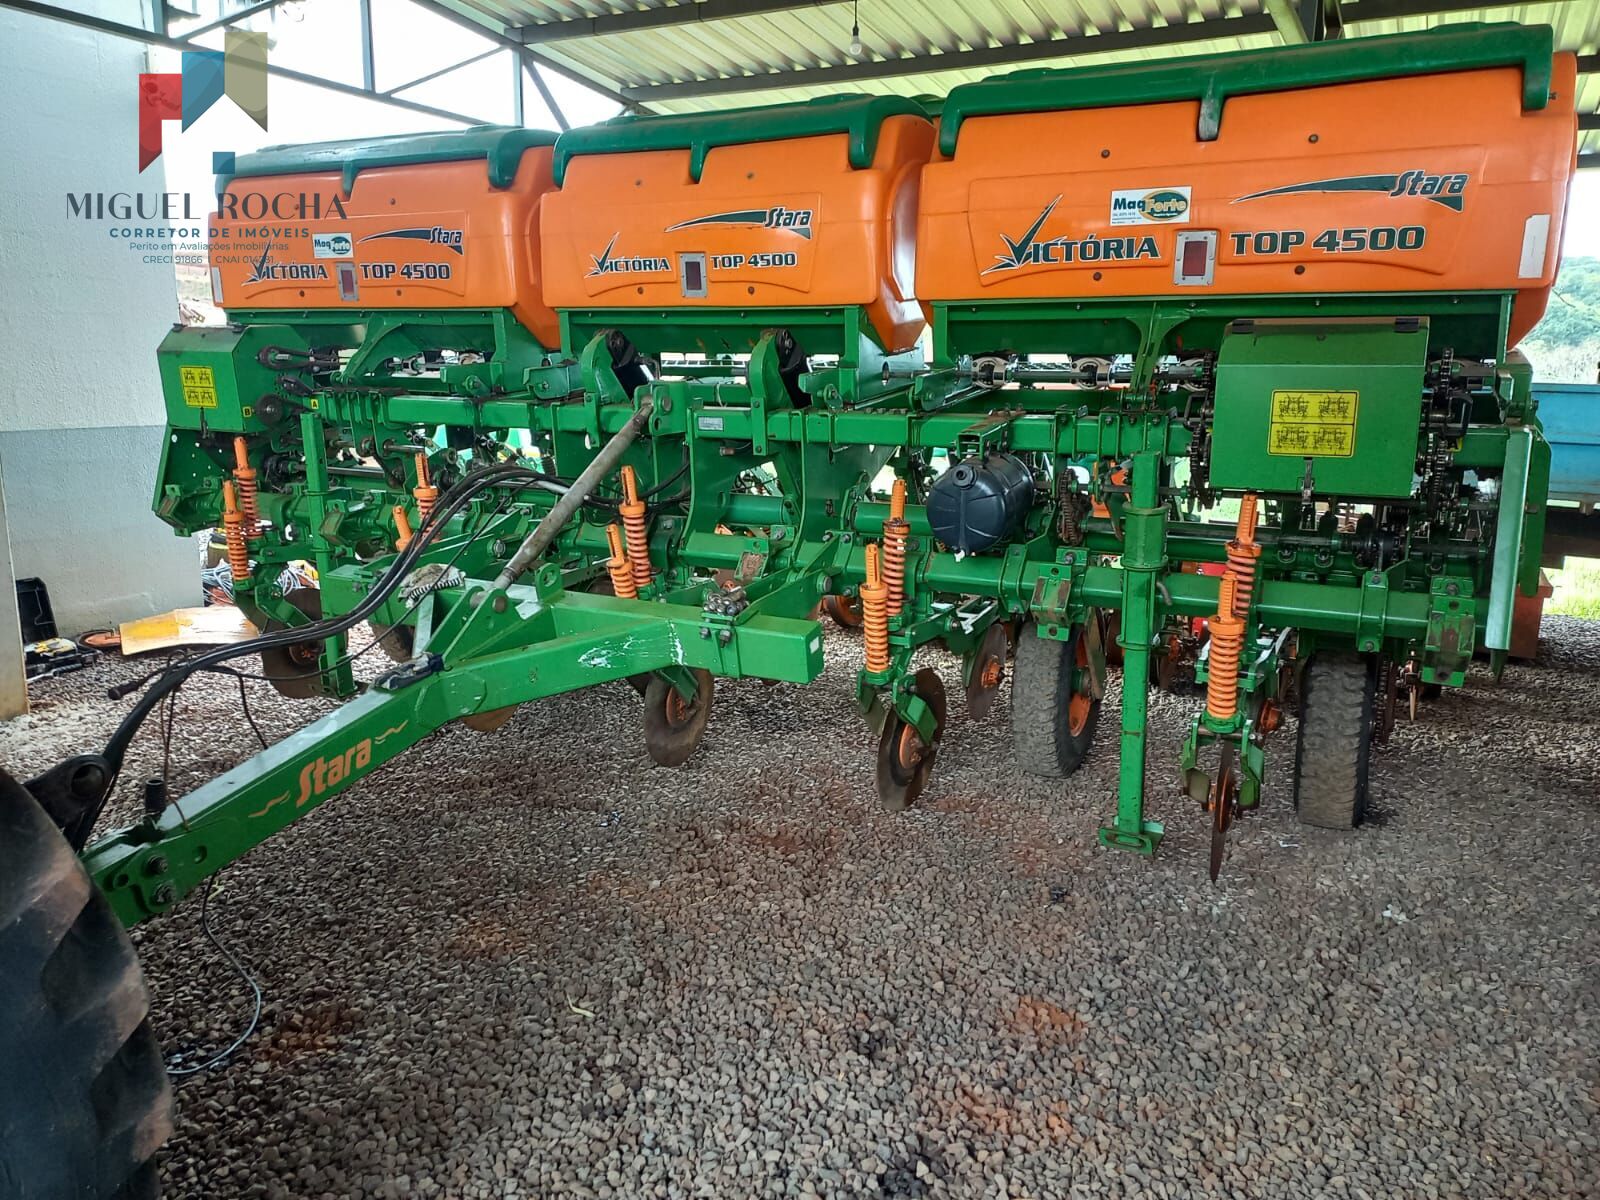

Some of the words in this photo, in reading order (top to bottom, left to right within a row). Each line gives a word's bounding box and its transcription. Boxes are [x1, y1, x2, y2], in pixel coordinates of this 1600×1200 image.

[1389, 170, 1469, 197] Stara
[764, 207, 812, 227] Stara
[429, 227, 463, 244] Stara
[1230, 230, 1305, 257] TOP
[1312, 226, 1426, 253] 4500
[711, 255, 743, 269] TOP
[747, 253, 797, 267] 4500
[360, 264, 396, 280] TOP
[400, 264, 450, 280] 4500
[296, 738, 372, 808] Stara
